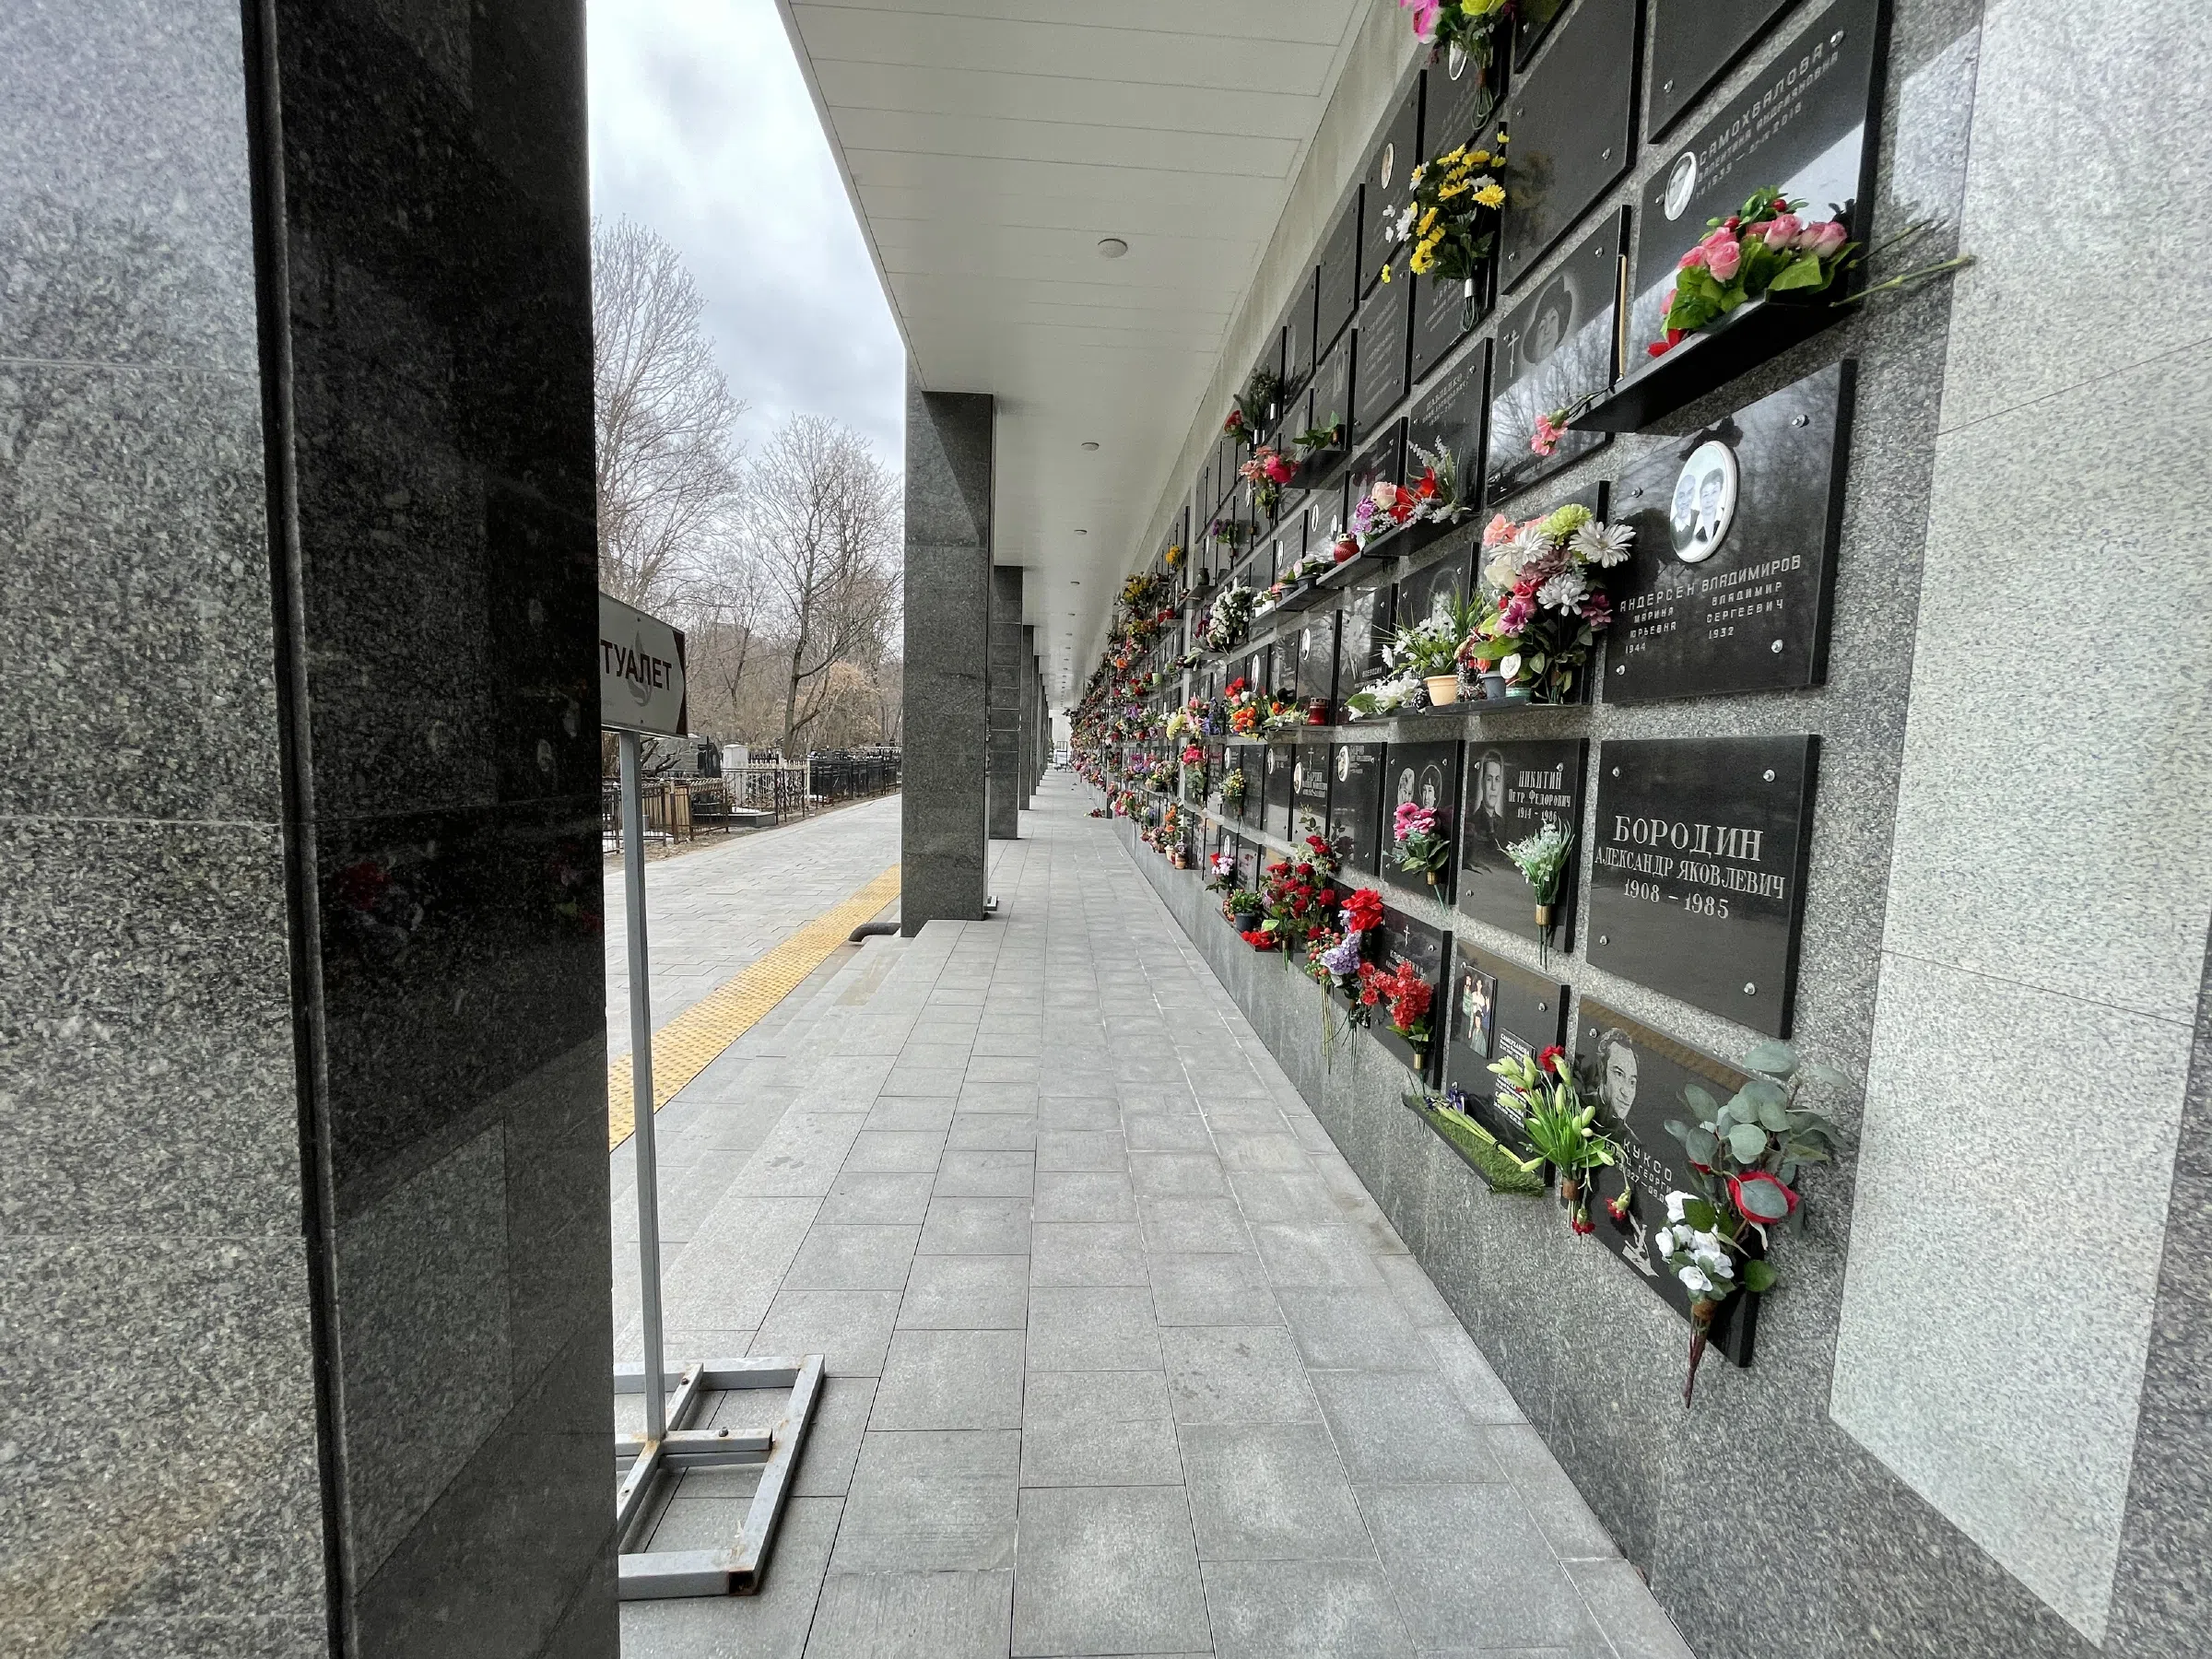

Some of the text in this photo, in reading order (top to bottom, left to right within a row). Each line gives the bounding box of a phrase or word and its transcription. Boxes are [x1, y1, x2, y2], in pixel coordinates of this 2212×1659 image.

[1700, 42, 1824, 166] САМОХВАЛОВА
[1619, 555, 1801, 613] АНДЕРСЕН ВЛАДИМИРОВ
[1712, 582, 1783, 606] ВЛАДИМИР
[1634, 606, 1674, 624] МАРИНА
[1707, 599, 1784, 623] СЕРГЕЕВИЧ
[1630, 621, 1677, 639] ЮРЬЕВНА
[1708, 626, 1735, 640] 1932
[1625, 642, 1646, 654] 1944
[600, 639, 672, 691] ТУАЛЕТ
[1519, 771, 1562, 790] НИКИТИН
[1541, 809, 1558, 822] 1986
[1613, 815, 1764, 862] БОРОДИН
[1594, 846, 1786, 900] АЛЕКСАНДР ЯКОВЛЕВИЧ
[1624, 878, 1660, 903] 1908
[1684, 893, 1729, 919] 1985
[1623, 1138, 1672, 1182] КУКСО
[1638, 1165, 1672, 1194] ГЕОРГИ
